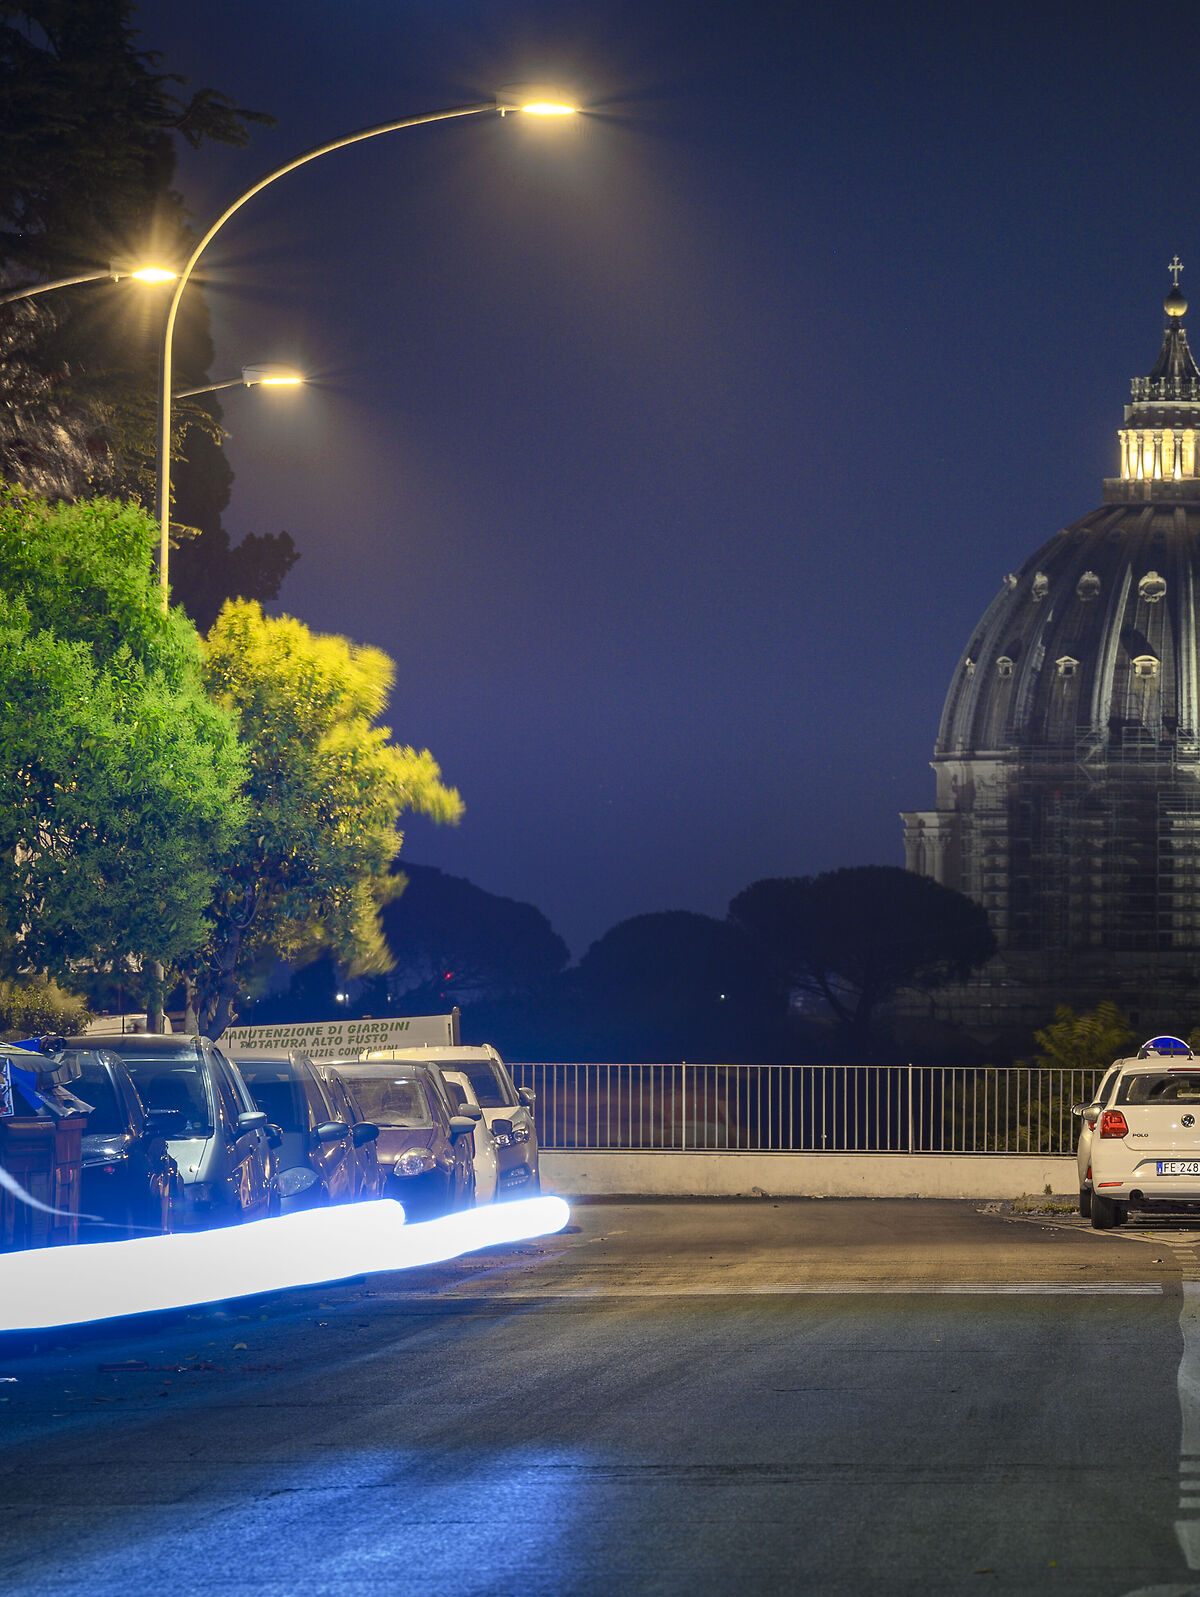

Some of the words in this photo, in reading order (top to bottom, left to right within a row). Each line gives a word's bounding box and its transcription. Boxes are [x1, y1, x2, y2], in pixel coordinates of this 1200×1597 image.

[328, 1025, 343, 1035] DI
[348, 1021, 411, 1033] GIARDINI
[312, 1036, 343, 1047] ALTO
[347, 1033, 388, 1044] FUSTO
[1164, 1163, 1176, 1172] FE
